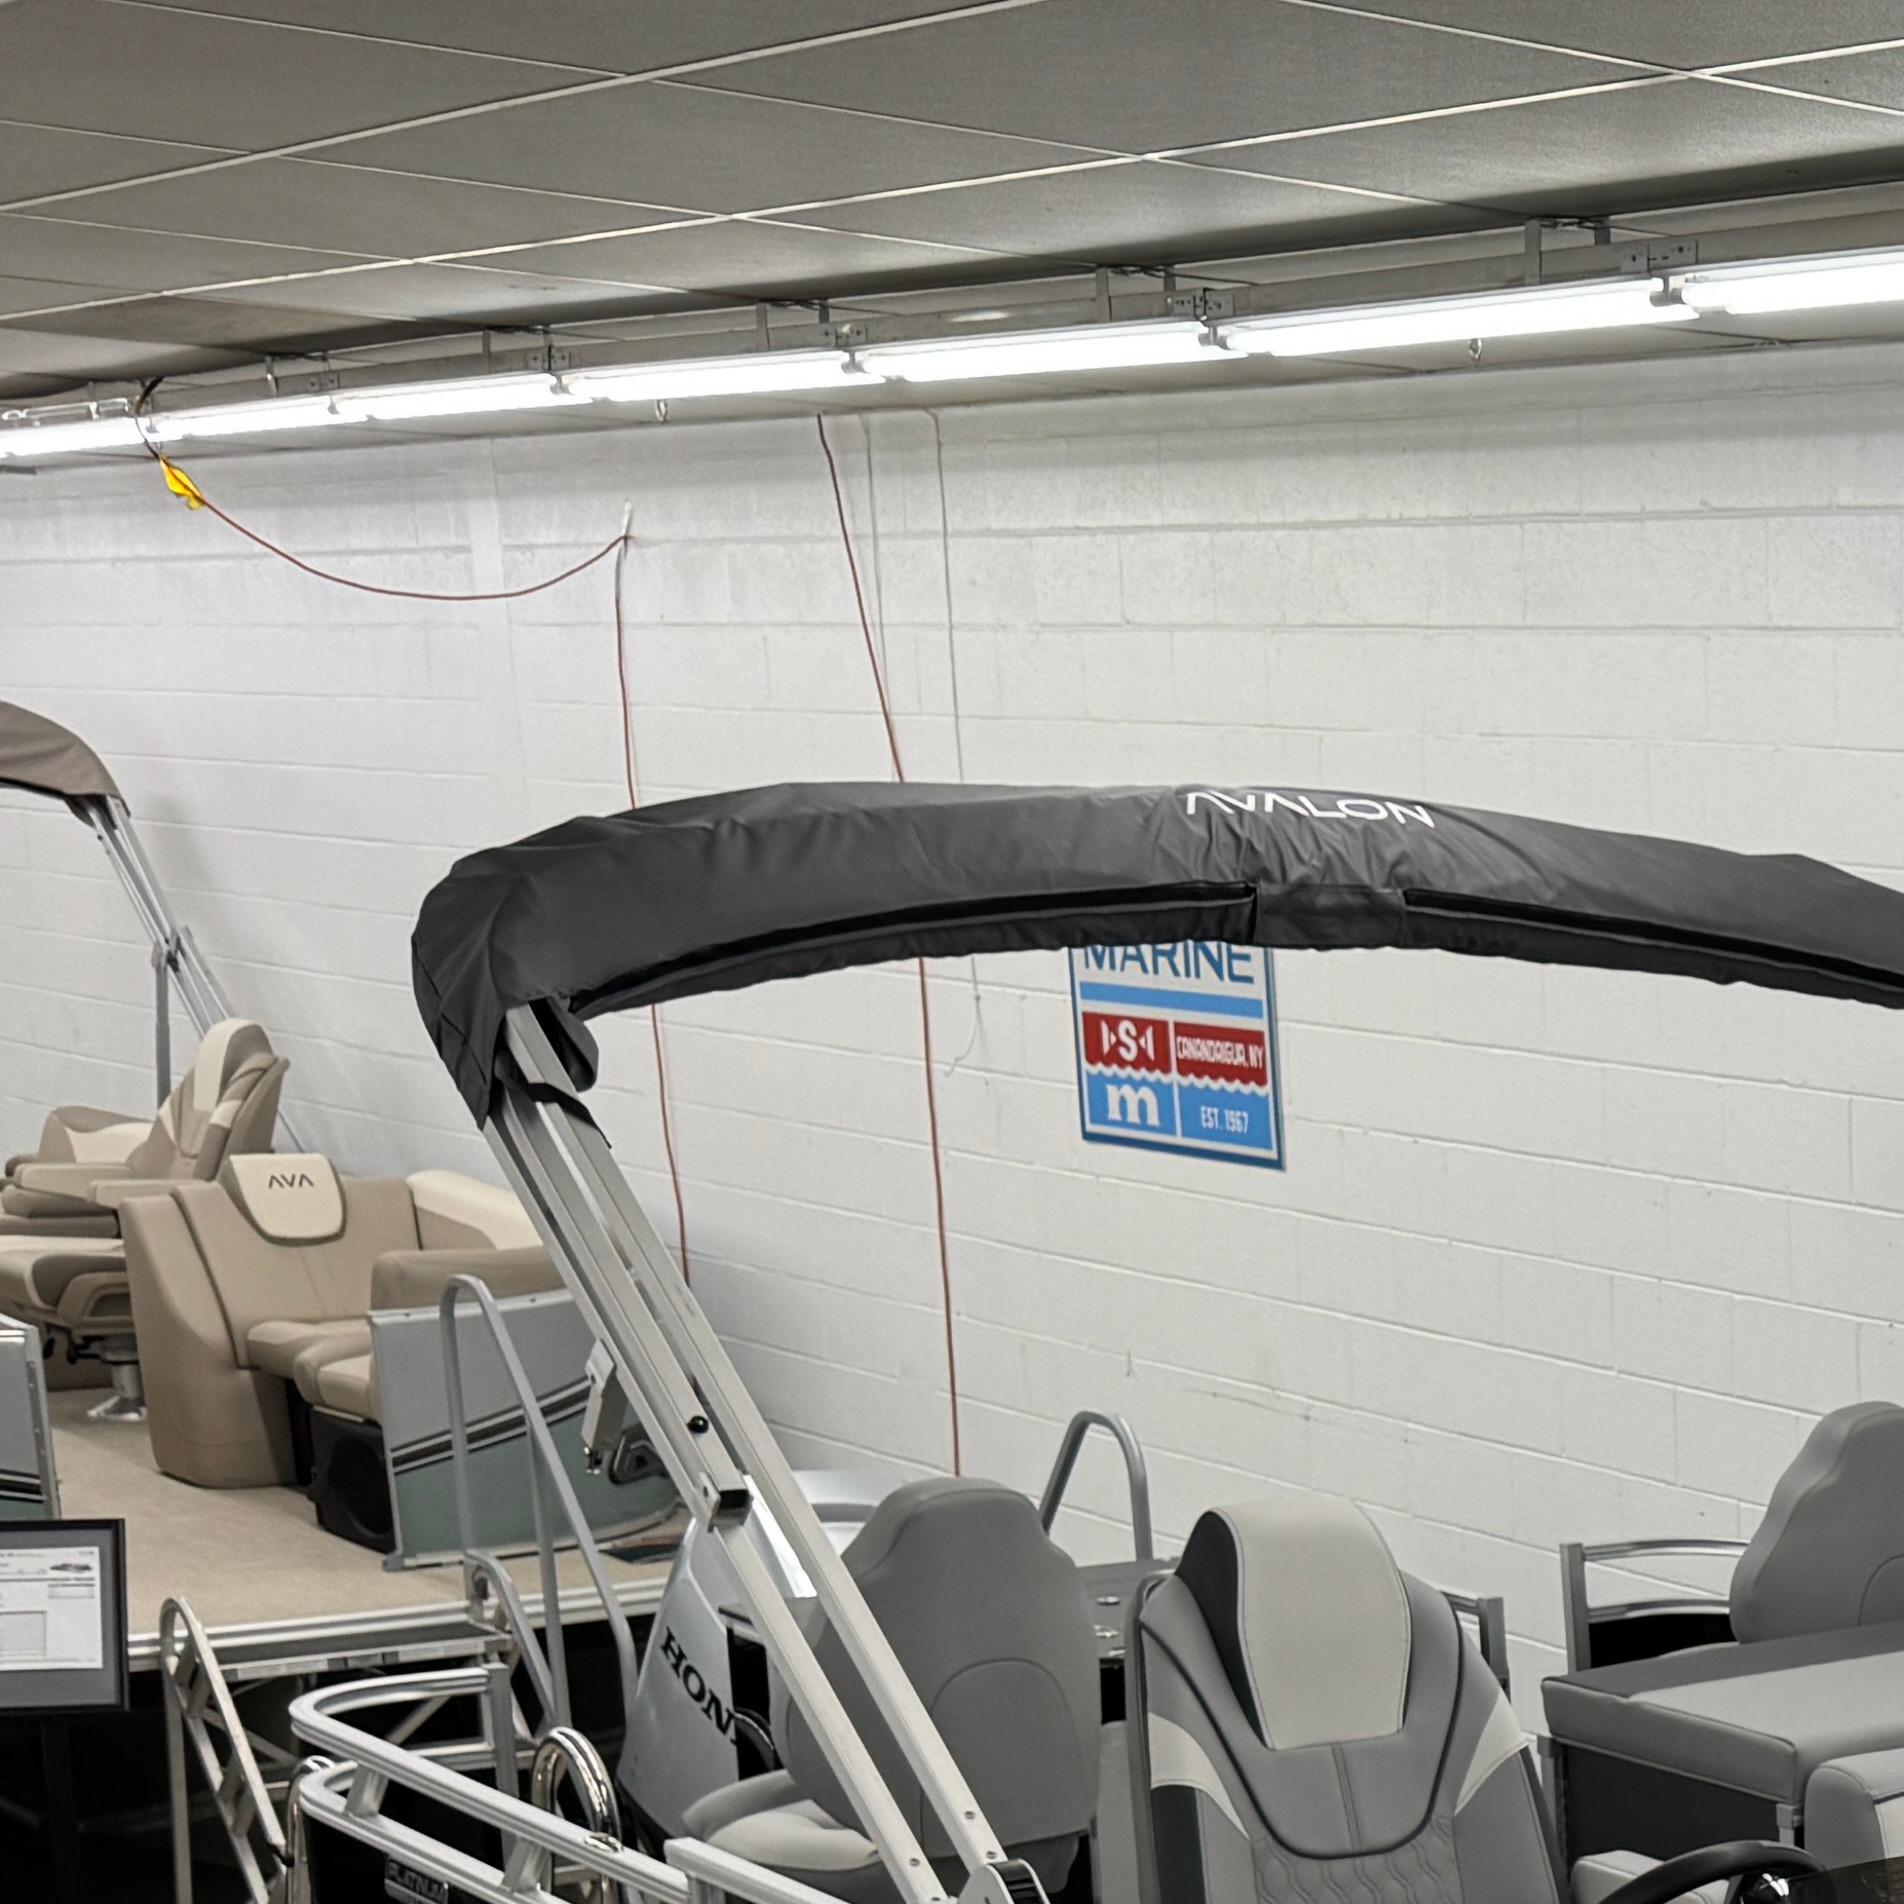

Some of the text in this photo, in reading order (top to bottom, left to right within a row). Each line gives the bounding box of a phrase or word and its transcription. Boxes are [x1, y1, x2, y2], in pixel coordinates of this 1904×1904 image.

[1187, 790, 1435, 828] AVALON
[1085, 940, 1254, 984] MARINE
[1249, 1044, 1264, 1069] NY
[1200, 1105, 1224, 1130] EST.
[268, 1173, 314, 1189] AVA
[660, 1626, 738, 1746] HON
